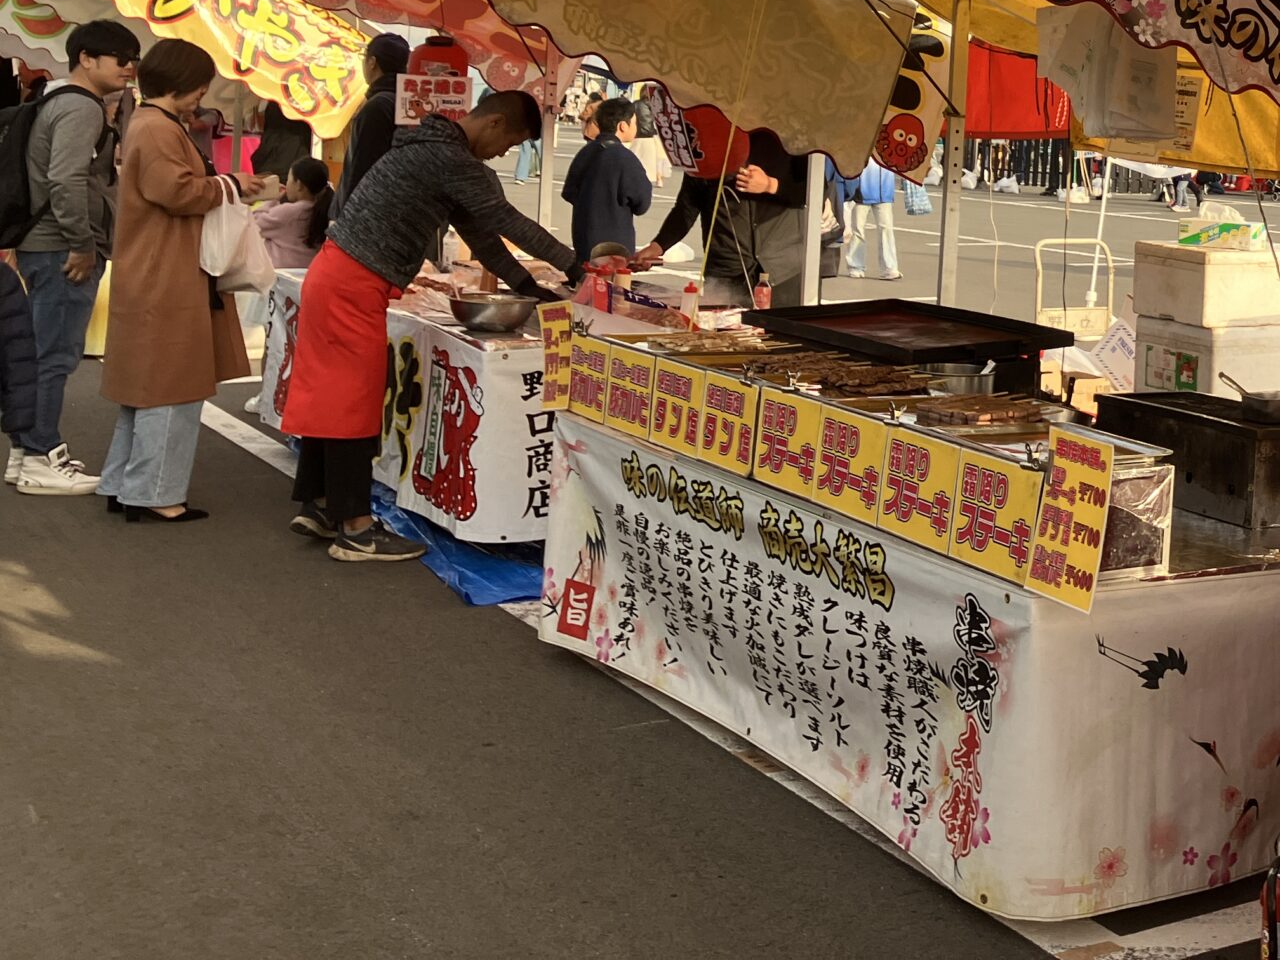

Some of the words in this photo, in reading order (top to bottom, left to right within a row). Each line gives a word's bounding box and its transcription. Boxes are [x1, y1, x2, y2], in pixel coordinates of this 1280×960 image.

[520, 369, 555, 519] 野口商店
[654, 396, 699, 447] タン塩
[702, 413, 752, 465] タン塩
[763, 399, 798, 437] 霜降り
[822, 417, 860, 458] 霜降り
[759, 431, 816, 485] ステーキ
[817, 452, 879, 510] ステーキ
[889, 438, 931, 483] 霜降り
[962, 462, 1009, 510] 霜降り
[620, 450, 744, 541] 味の伝道師
[758, 500, 895, 613] 商売大繁昌
[883, 475, 951, 538] ステーキ
[956, 500, 1031, 568] ステーキ
[1072, 521, 1101, 549] ¥700
[566, 587, 589, 628] 旨
[673, 529, 698, 633] 絶品の串焼を
[697, 538, 728, 677] とびきり美味しい
[719, 548, 741, 640] 仕上げます
[741, 560, 773, 706] 最適な火加減にて
[766, 570, 797, 719] 焼きにもこだわり
[845, 609, 873, 692] 味つけは
[821, 597, 851, 748] クレージーソルト
[872, 620, 907, 790] 良質な素材を使用
[902, 635, 940, 826] 串焼職人がこだわる
